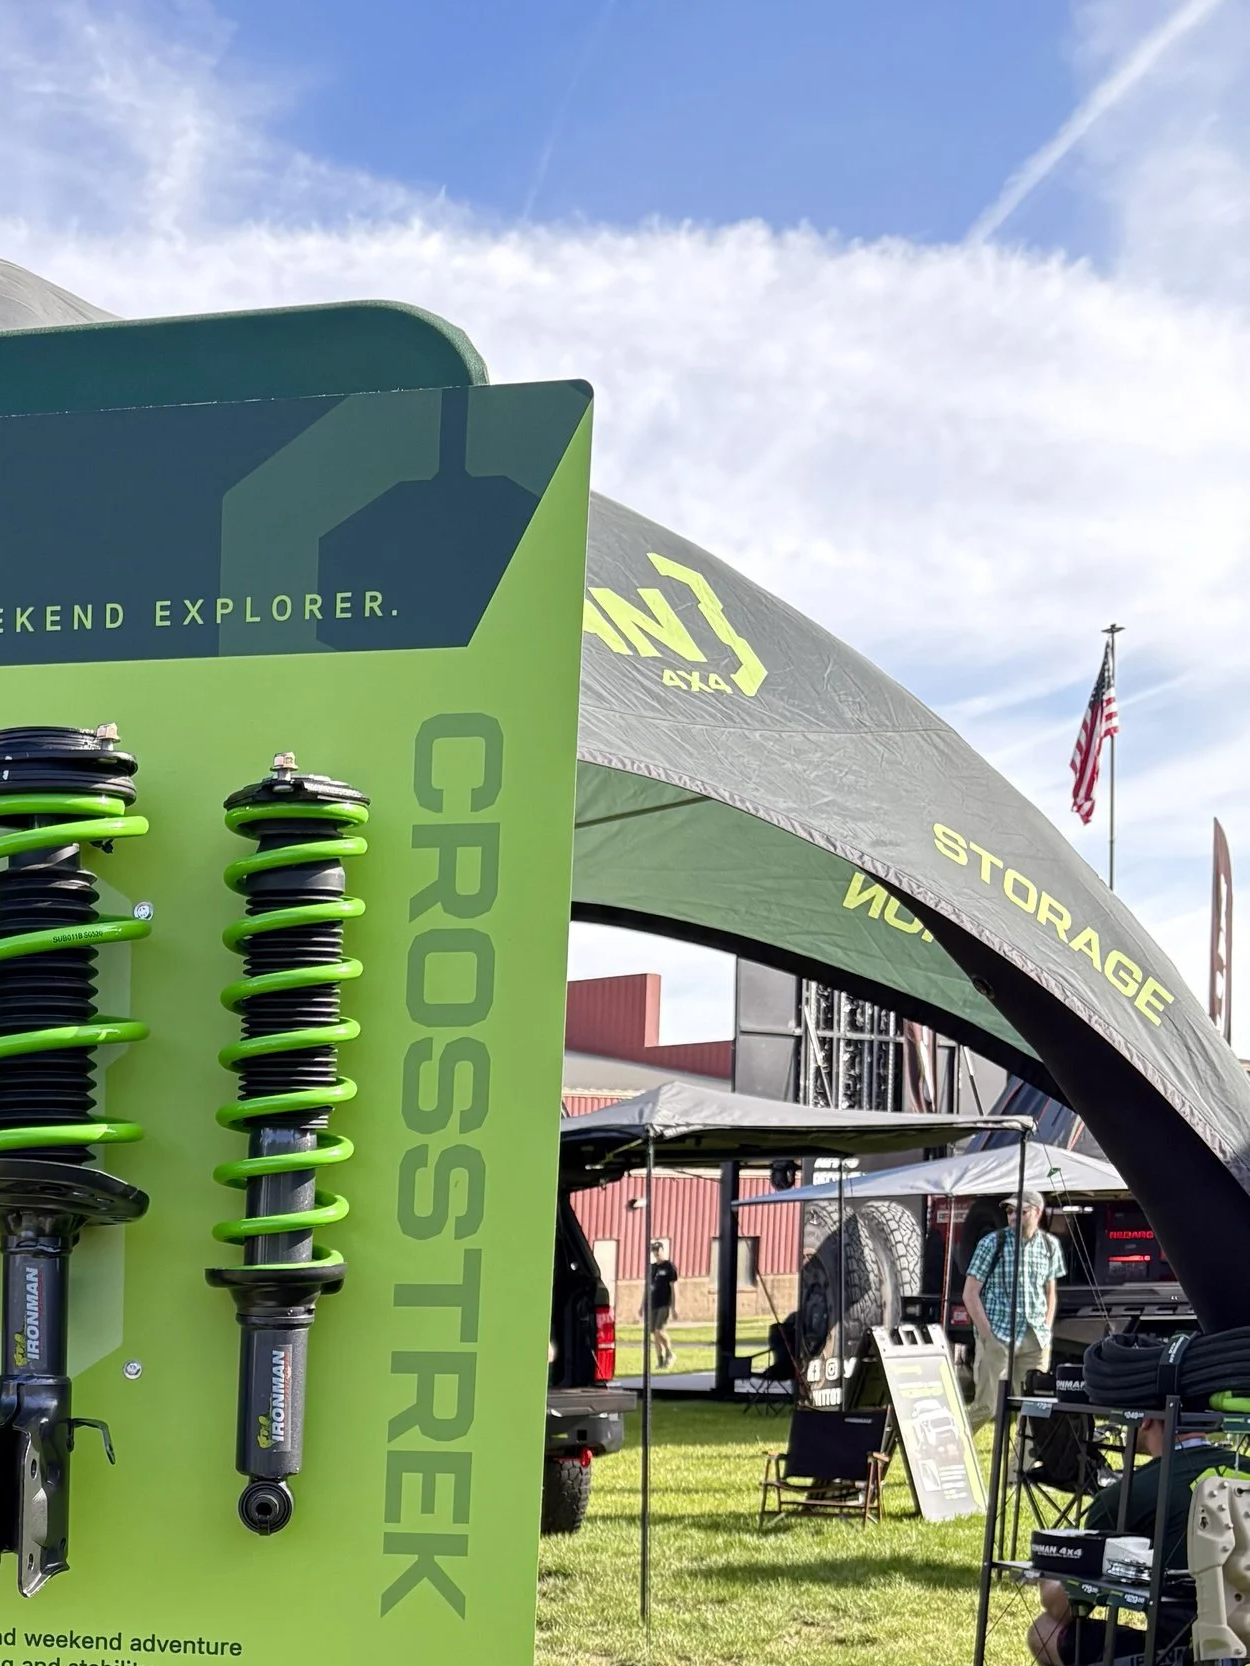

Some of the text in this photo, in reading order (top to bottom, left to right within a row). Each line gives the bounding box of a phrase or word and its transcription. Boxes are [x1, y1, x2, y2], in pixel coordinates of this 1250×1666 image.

[154, 590, 399, 627] EXPLORER.
[932, 822, 1175, 1027] STORAGE
[380, 711, 504, 1621] CROSSTREK
[26, 1267, 40, 1360] IRONMAN
[272, 1350, 285, 1442] IRONMAN
[23, 1629, 122, 1651] weekend
[129, 1633, 243, 1657] adventure
